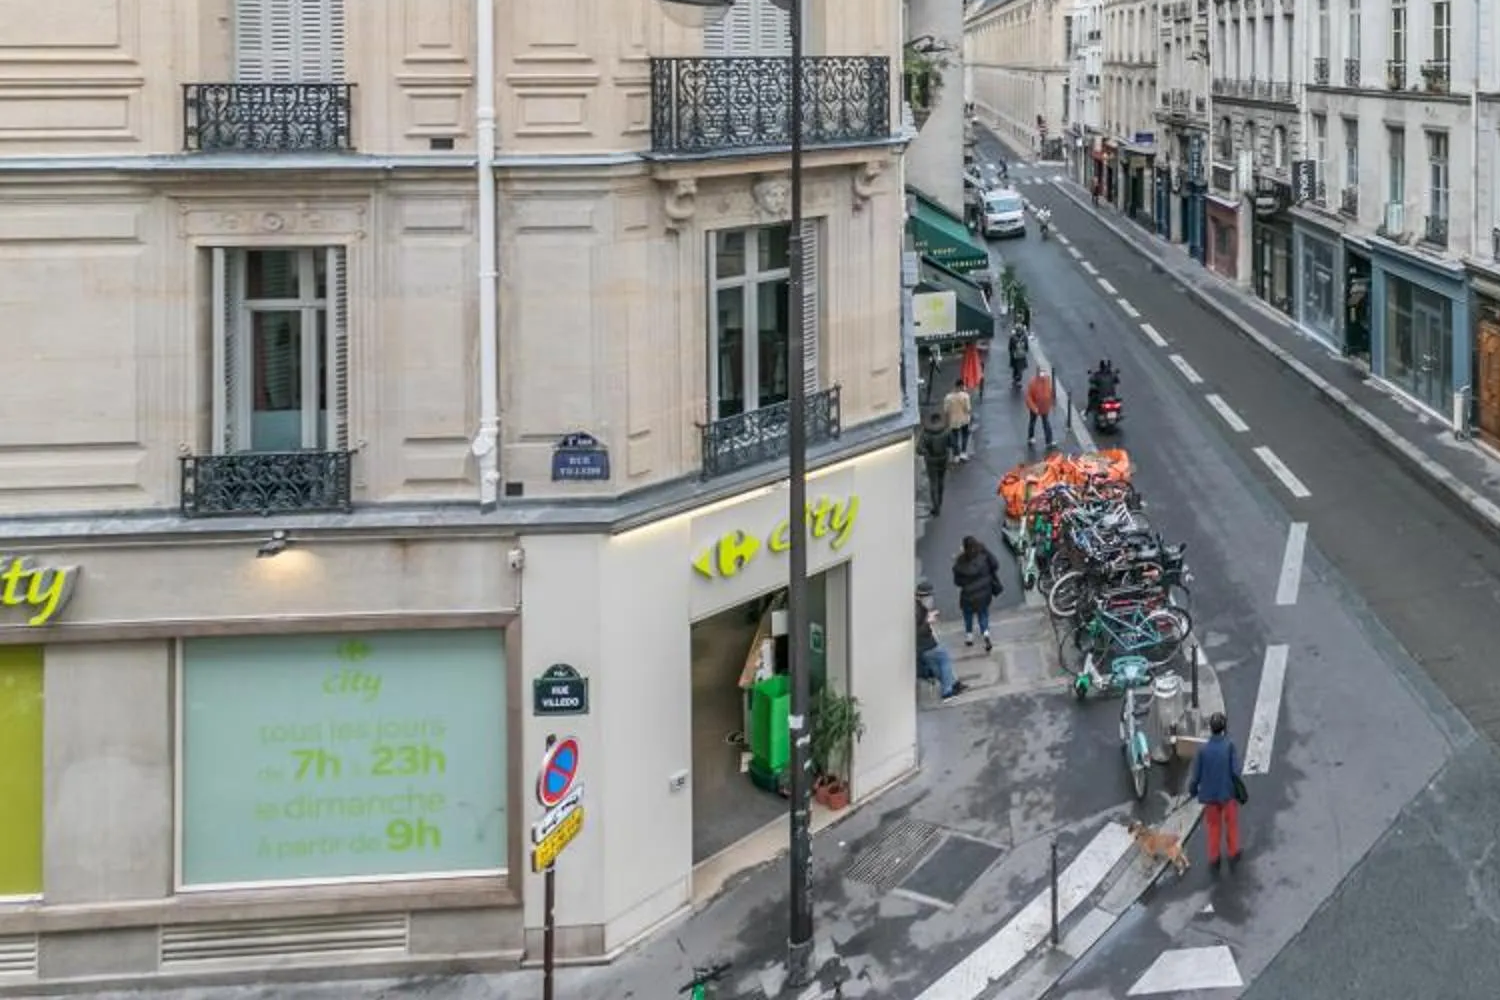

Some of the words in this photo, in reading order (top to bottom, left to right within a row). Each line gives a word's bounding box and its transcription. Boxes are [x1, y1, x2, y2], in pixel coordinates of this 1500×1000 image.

[769, 494, 860, 552] cty
[542, 697, 580, 707] VILLEDO
[551, 686, 569, 695] RUE
[290, 749, 342, 782] 7h
[370, 745, 446, 776] 23h
[385, 818, 441, 851] 9h
